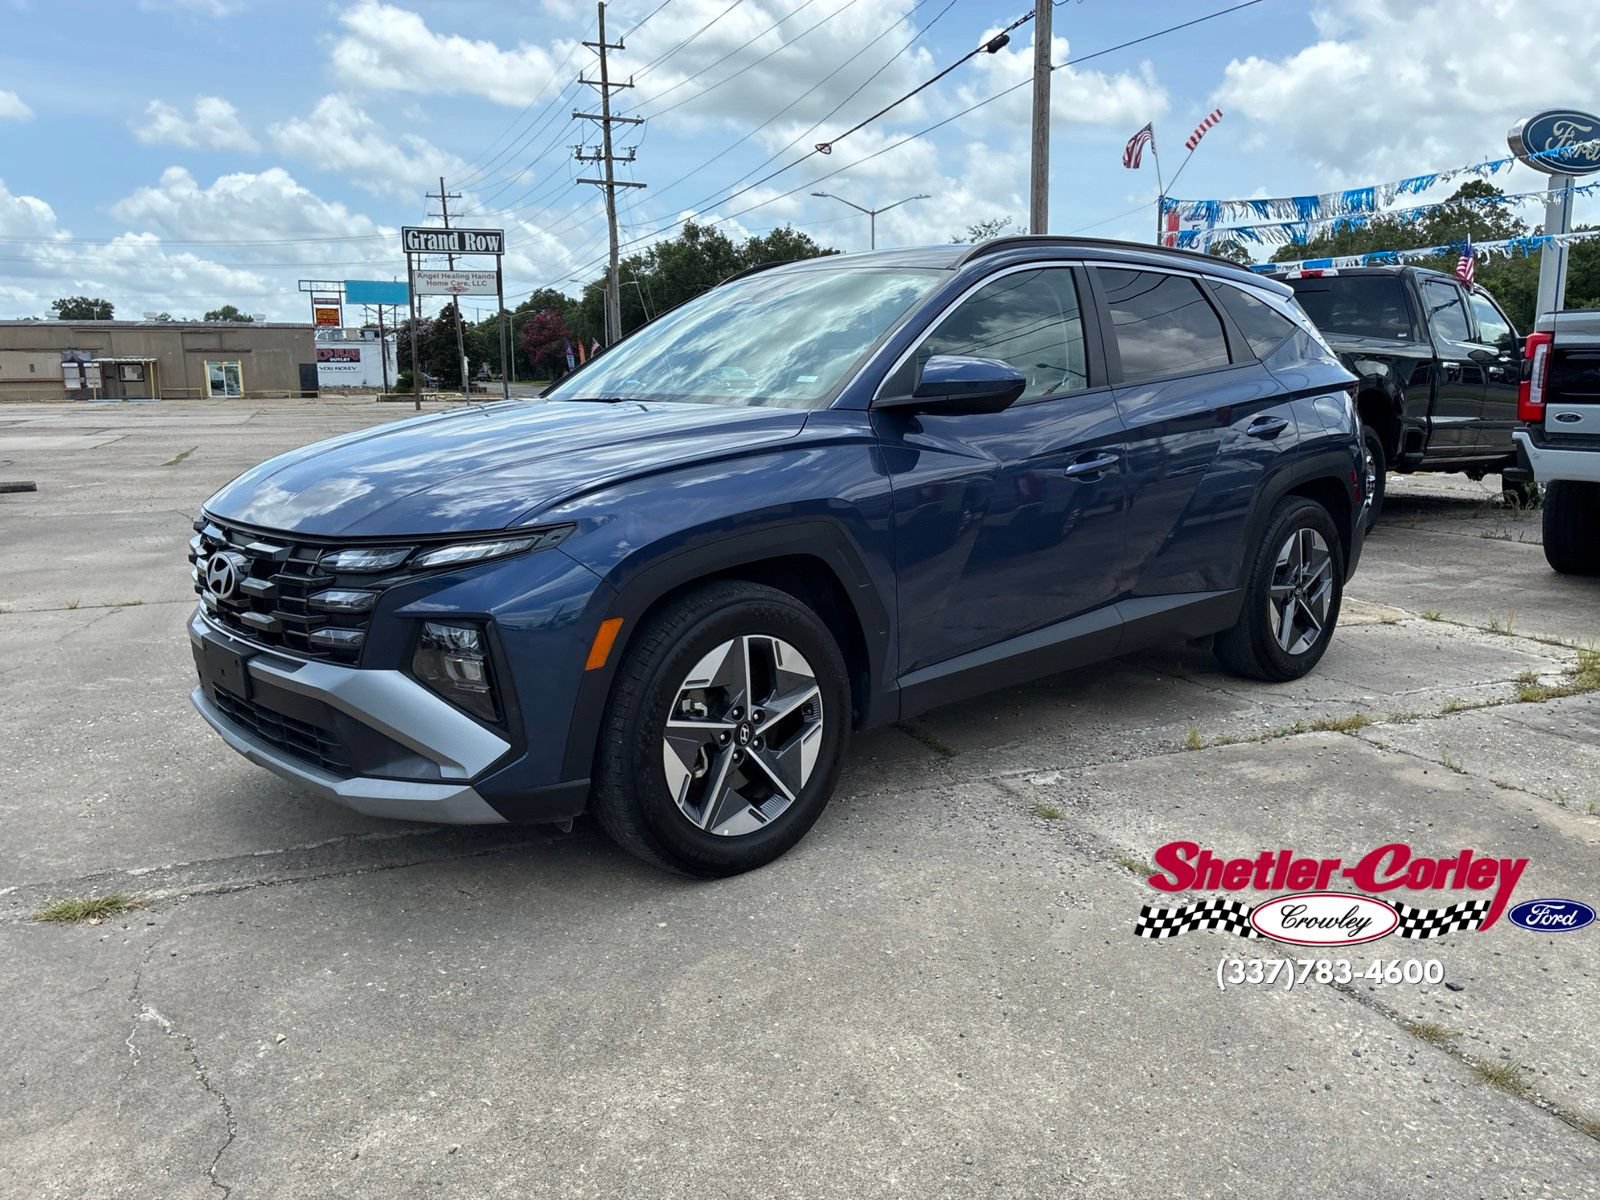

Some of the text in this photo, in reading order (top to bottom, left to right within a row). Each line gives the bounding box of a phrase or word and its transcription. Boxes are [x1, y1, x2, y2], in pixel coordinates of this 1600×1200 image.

[407, 230, 499, 252] Grand Row
[417, 272, 439, 280] Angel
[441, 273, 470, 281] Healing
[335, 348, 360, 361] PLUS
[1560, 414, 1577, 422] Ford
